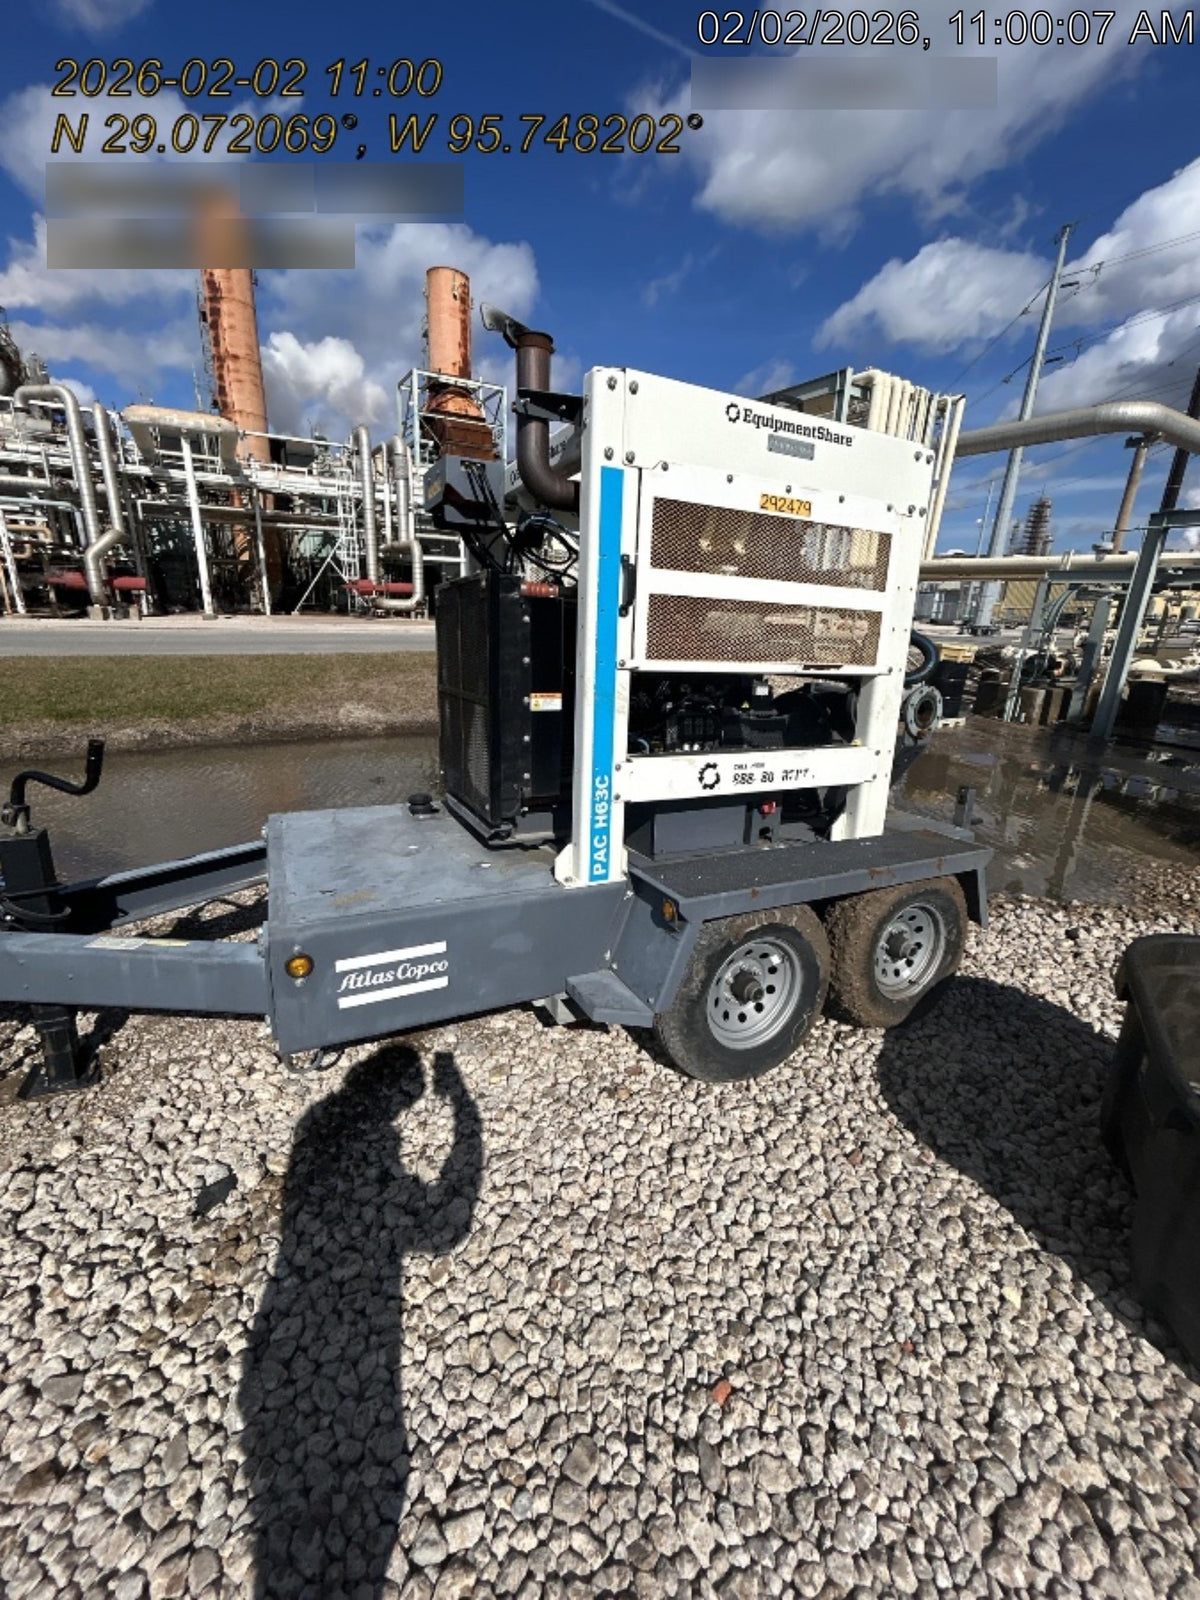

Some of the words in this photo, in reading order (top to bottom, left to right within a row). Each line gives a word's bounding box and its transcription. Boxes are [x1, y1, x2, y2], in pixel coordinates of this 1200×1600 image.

[742, 408, 854, 447] EquipmentShare
[760, 493, 812, 516] 292479
[593, 834, 607, 876] PAC
[336, 969, 395, 993] Atlas
[395, 959, 449, 980] Copco
